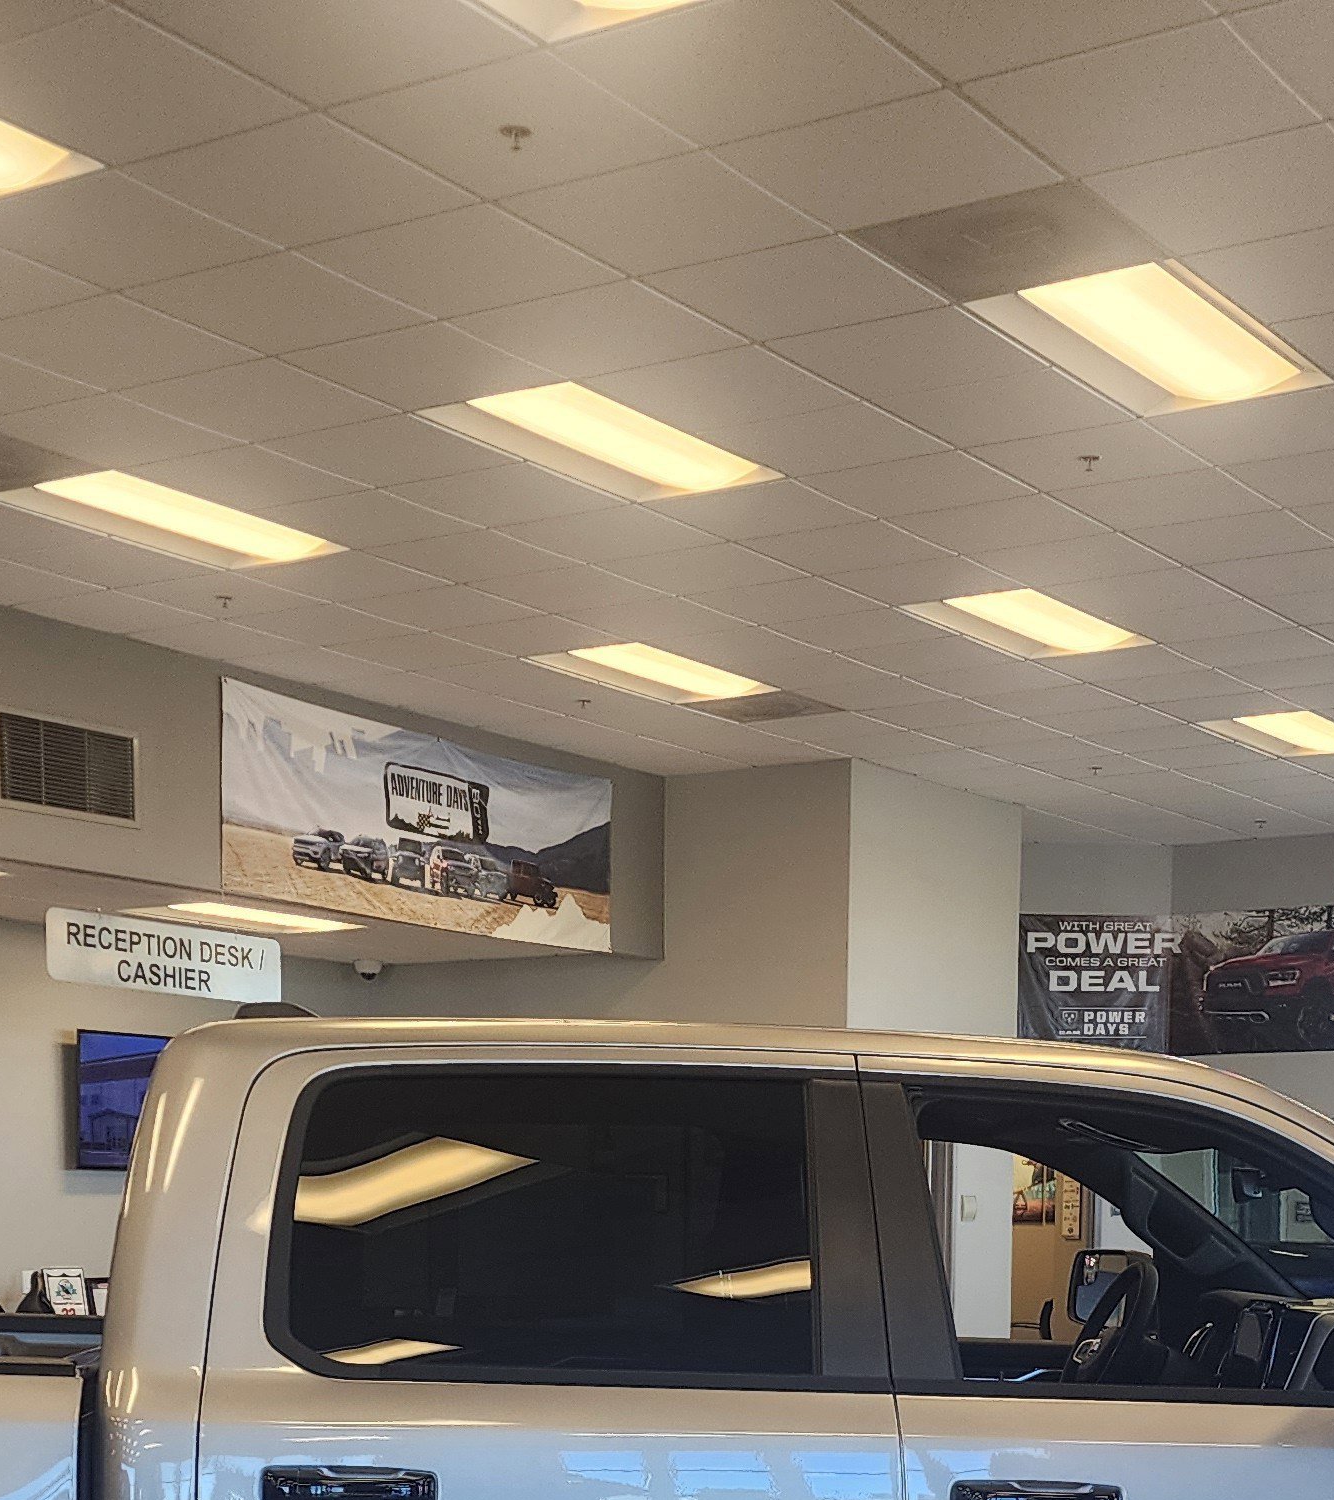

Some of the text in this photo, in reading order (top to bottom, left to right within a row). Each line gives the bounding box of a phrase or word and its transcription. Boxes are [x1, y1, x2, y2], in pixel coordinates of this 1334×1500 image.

[390, 772, 469, 812] ADVENTURE DAYS
[1059, 921, 1153, 931] WITH GREAT
[66, 921, 265, 971] RECEPTION DESK /
[1026, 931, 1183, 955] POWER
[1045, 957, 1167, 967] COMES A GREAT
[117, 959, 212, 993] CASHIER
[1048, 969, 1160, 993] DEAL
[1083, 1011, 1146, 1023] POWER
[1083, 1023, 1129, 1035] DAYS
